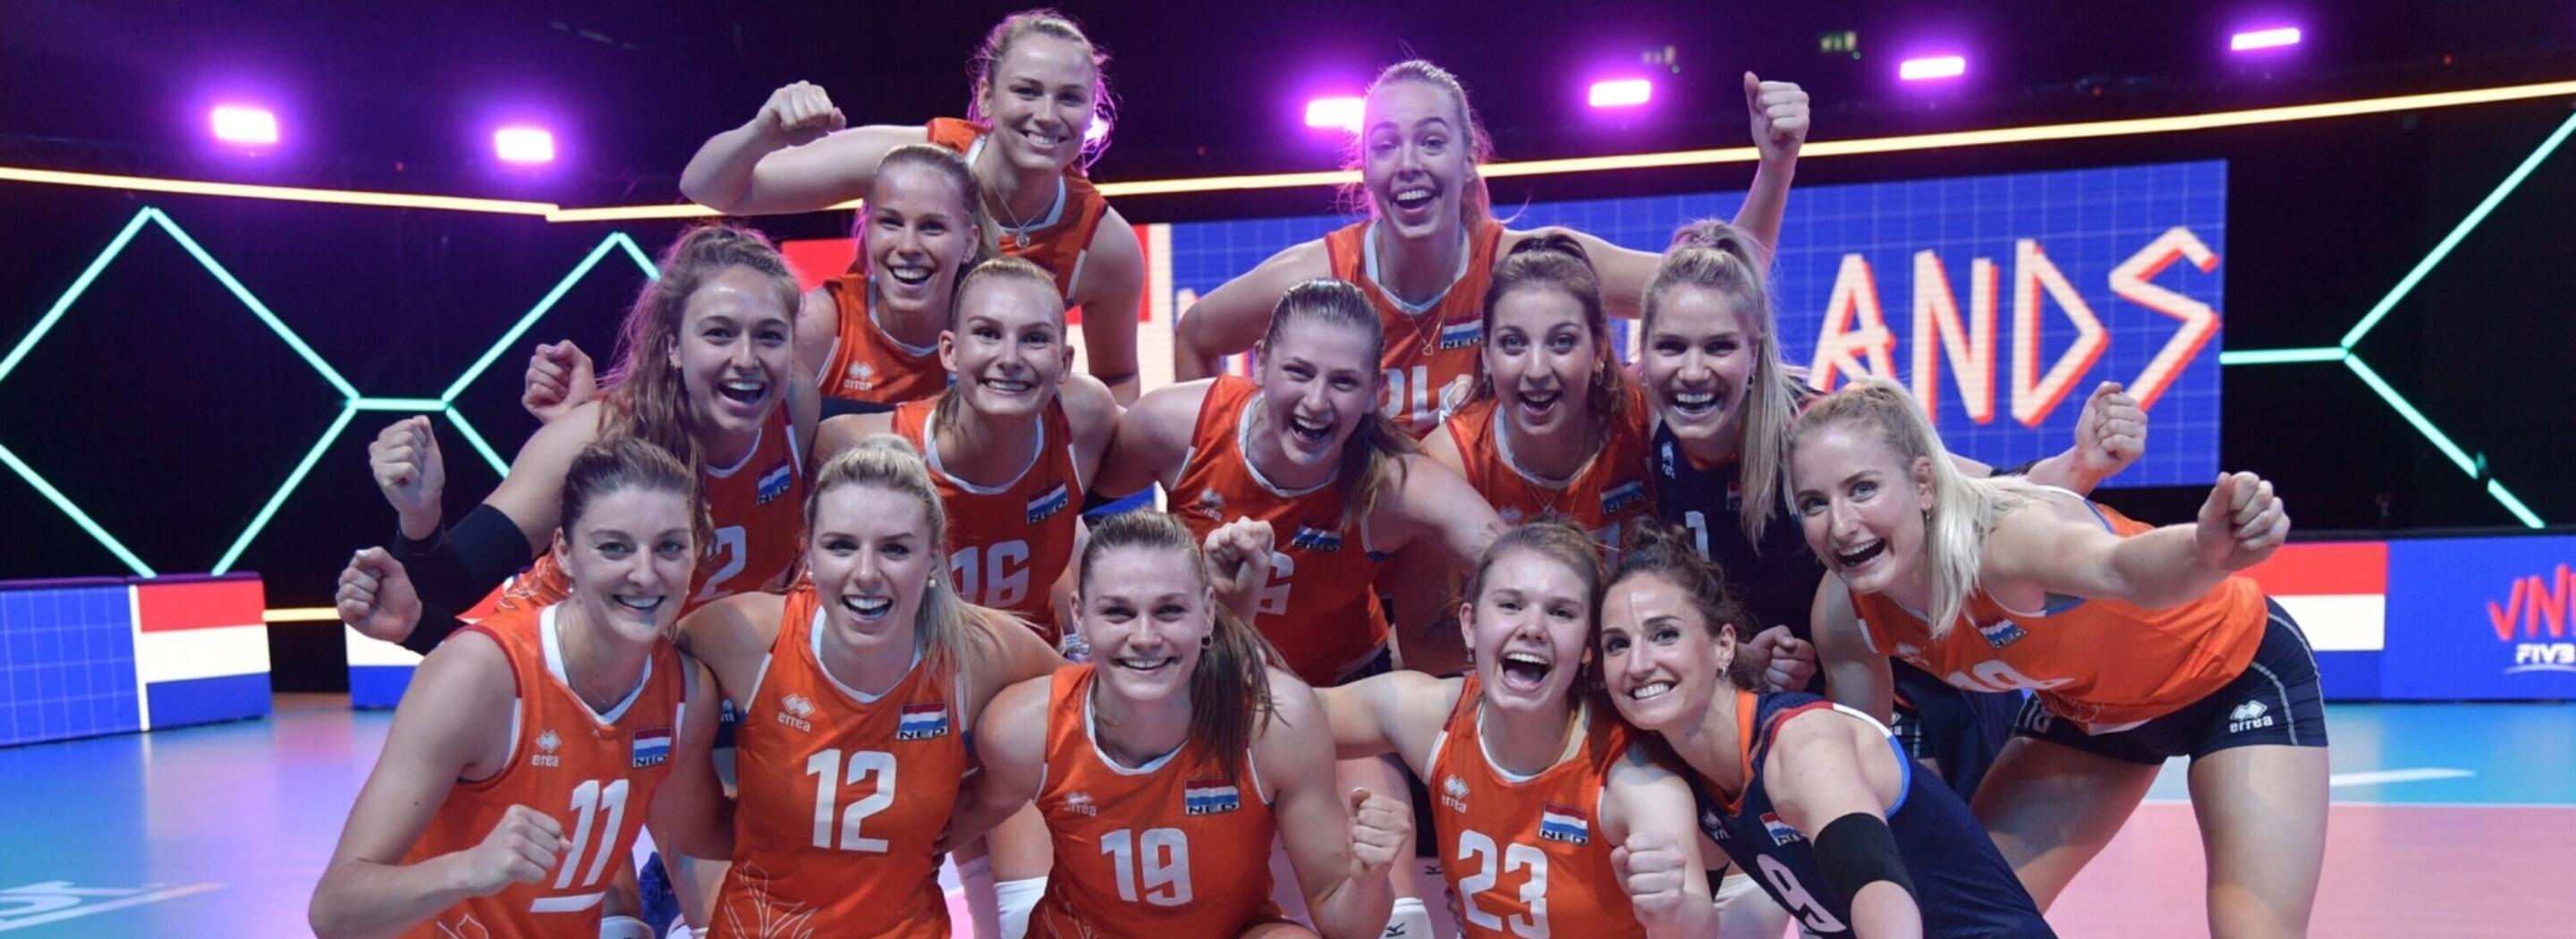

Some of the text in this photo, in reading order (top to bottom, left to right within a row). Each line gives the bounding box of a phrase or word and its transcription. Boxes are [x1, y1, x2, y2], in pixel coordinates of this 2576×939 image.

[950, 539, 1030, 608] 16
[2487, 563, 2576, 641] VN
[777, 712, 811, 732] errea
[899, 727, 945, 740] NED
[2229, 715, 2274, 733] errea
[553, 779, 630, 890] 11
[807, 748, 897, 852] 12
[1189, 803, 1238, 814] NED
[1441, 795, 1468, 813] errea
[1100, 827, 1193, 907] 19
[1541, 829, 1588, 843] NED
[1458, 829, 1551, 939] 23
[1756, 852, 1848, 933] 9
